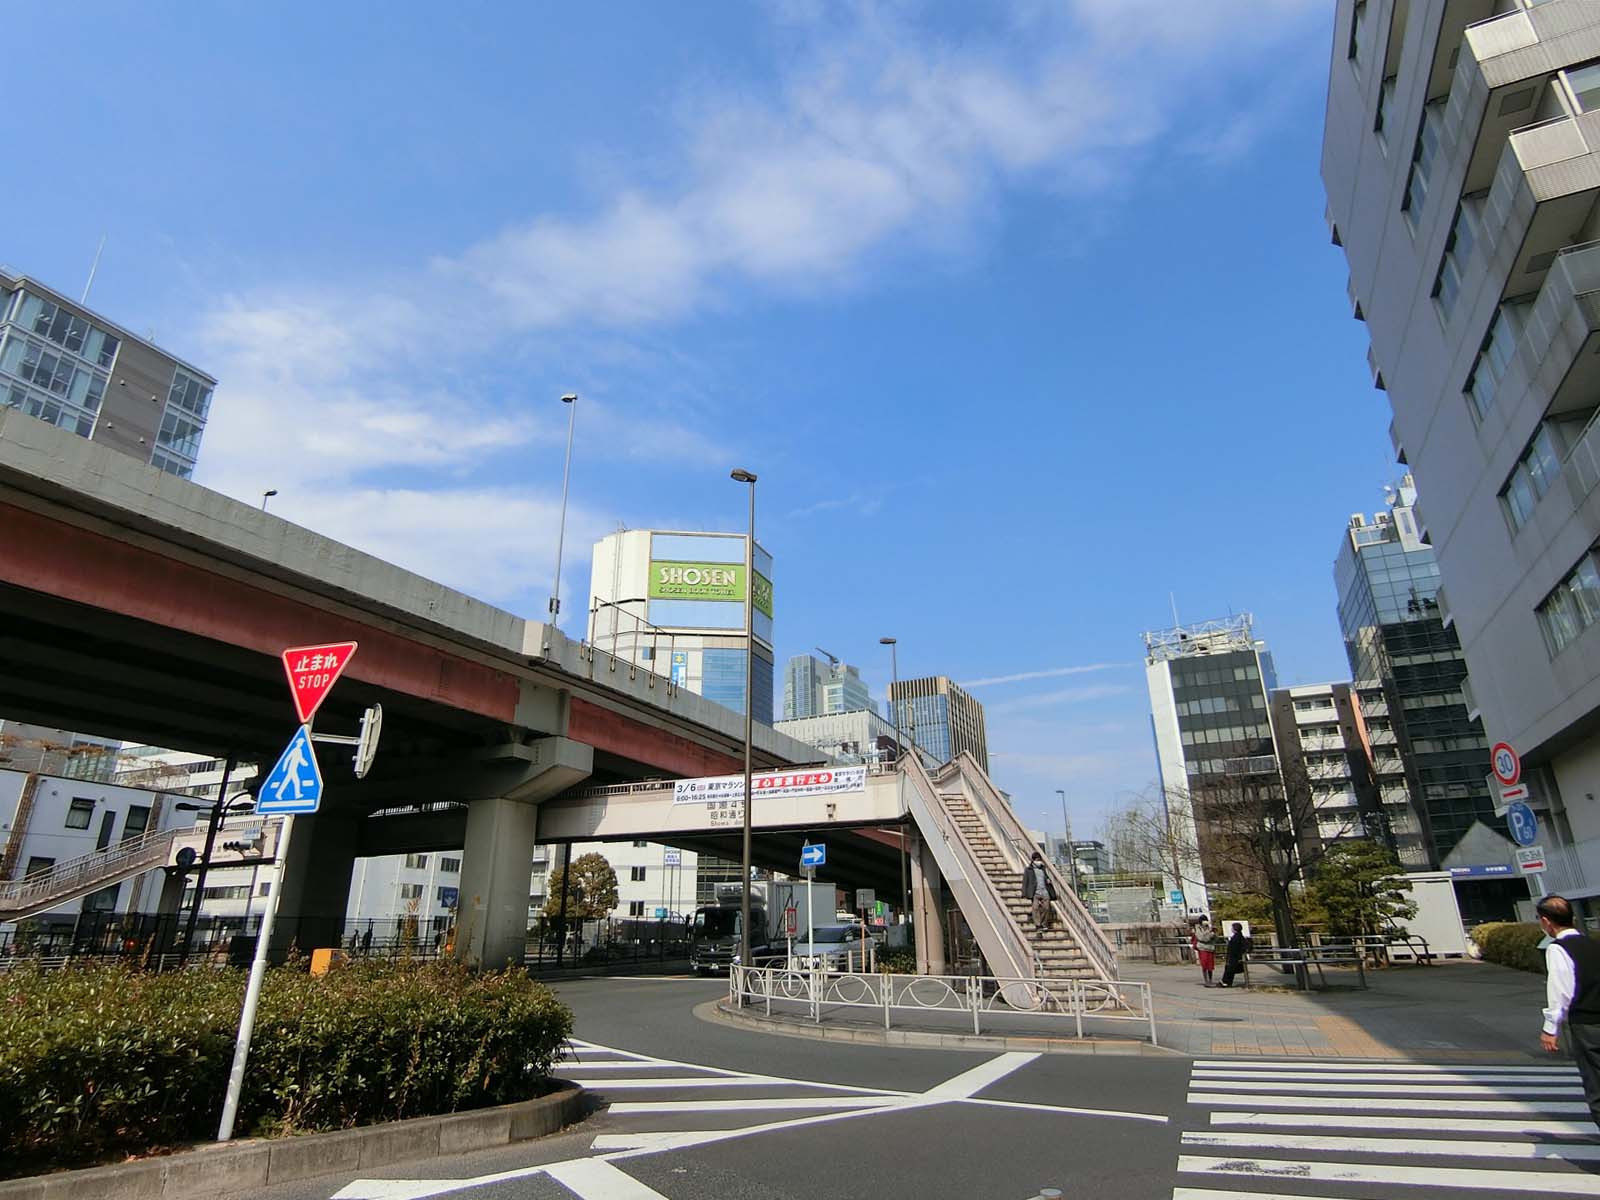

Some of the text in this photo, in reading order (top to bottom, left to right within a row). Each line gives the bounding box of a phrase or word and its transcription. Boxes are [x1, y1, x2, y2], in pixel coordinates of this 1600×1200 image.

[659, 567, 736, 587] SHOSEN
[294, 653, 338, 672] 止まれ
[298, 674, 330, 689] STOP
[1497, 753, 1513, 774] 30
